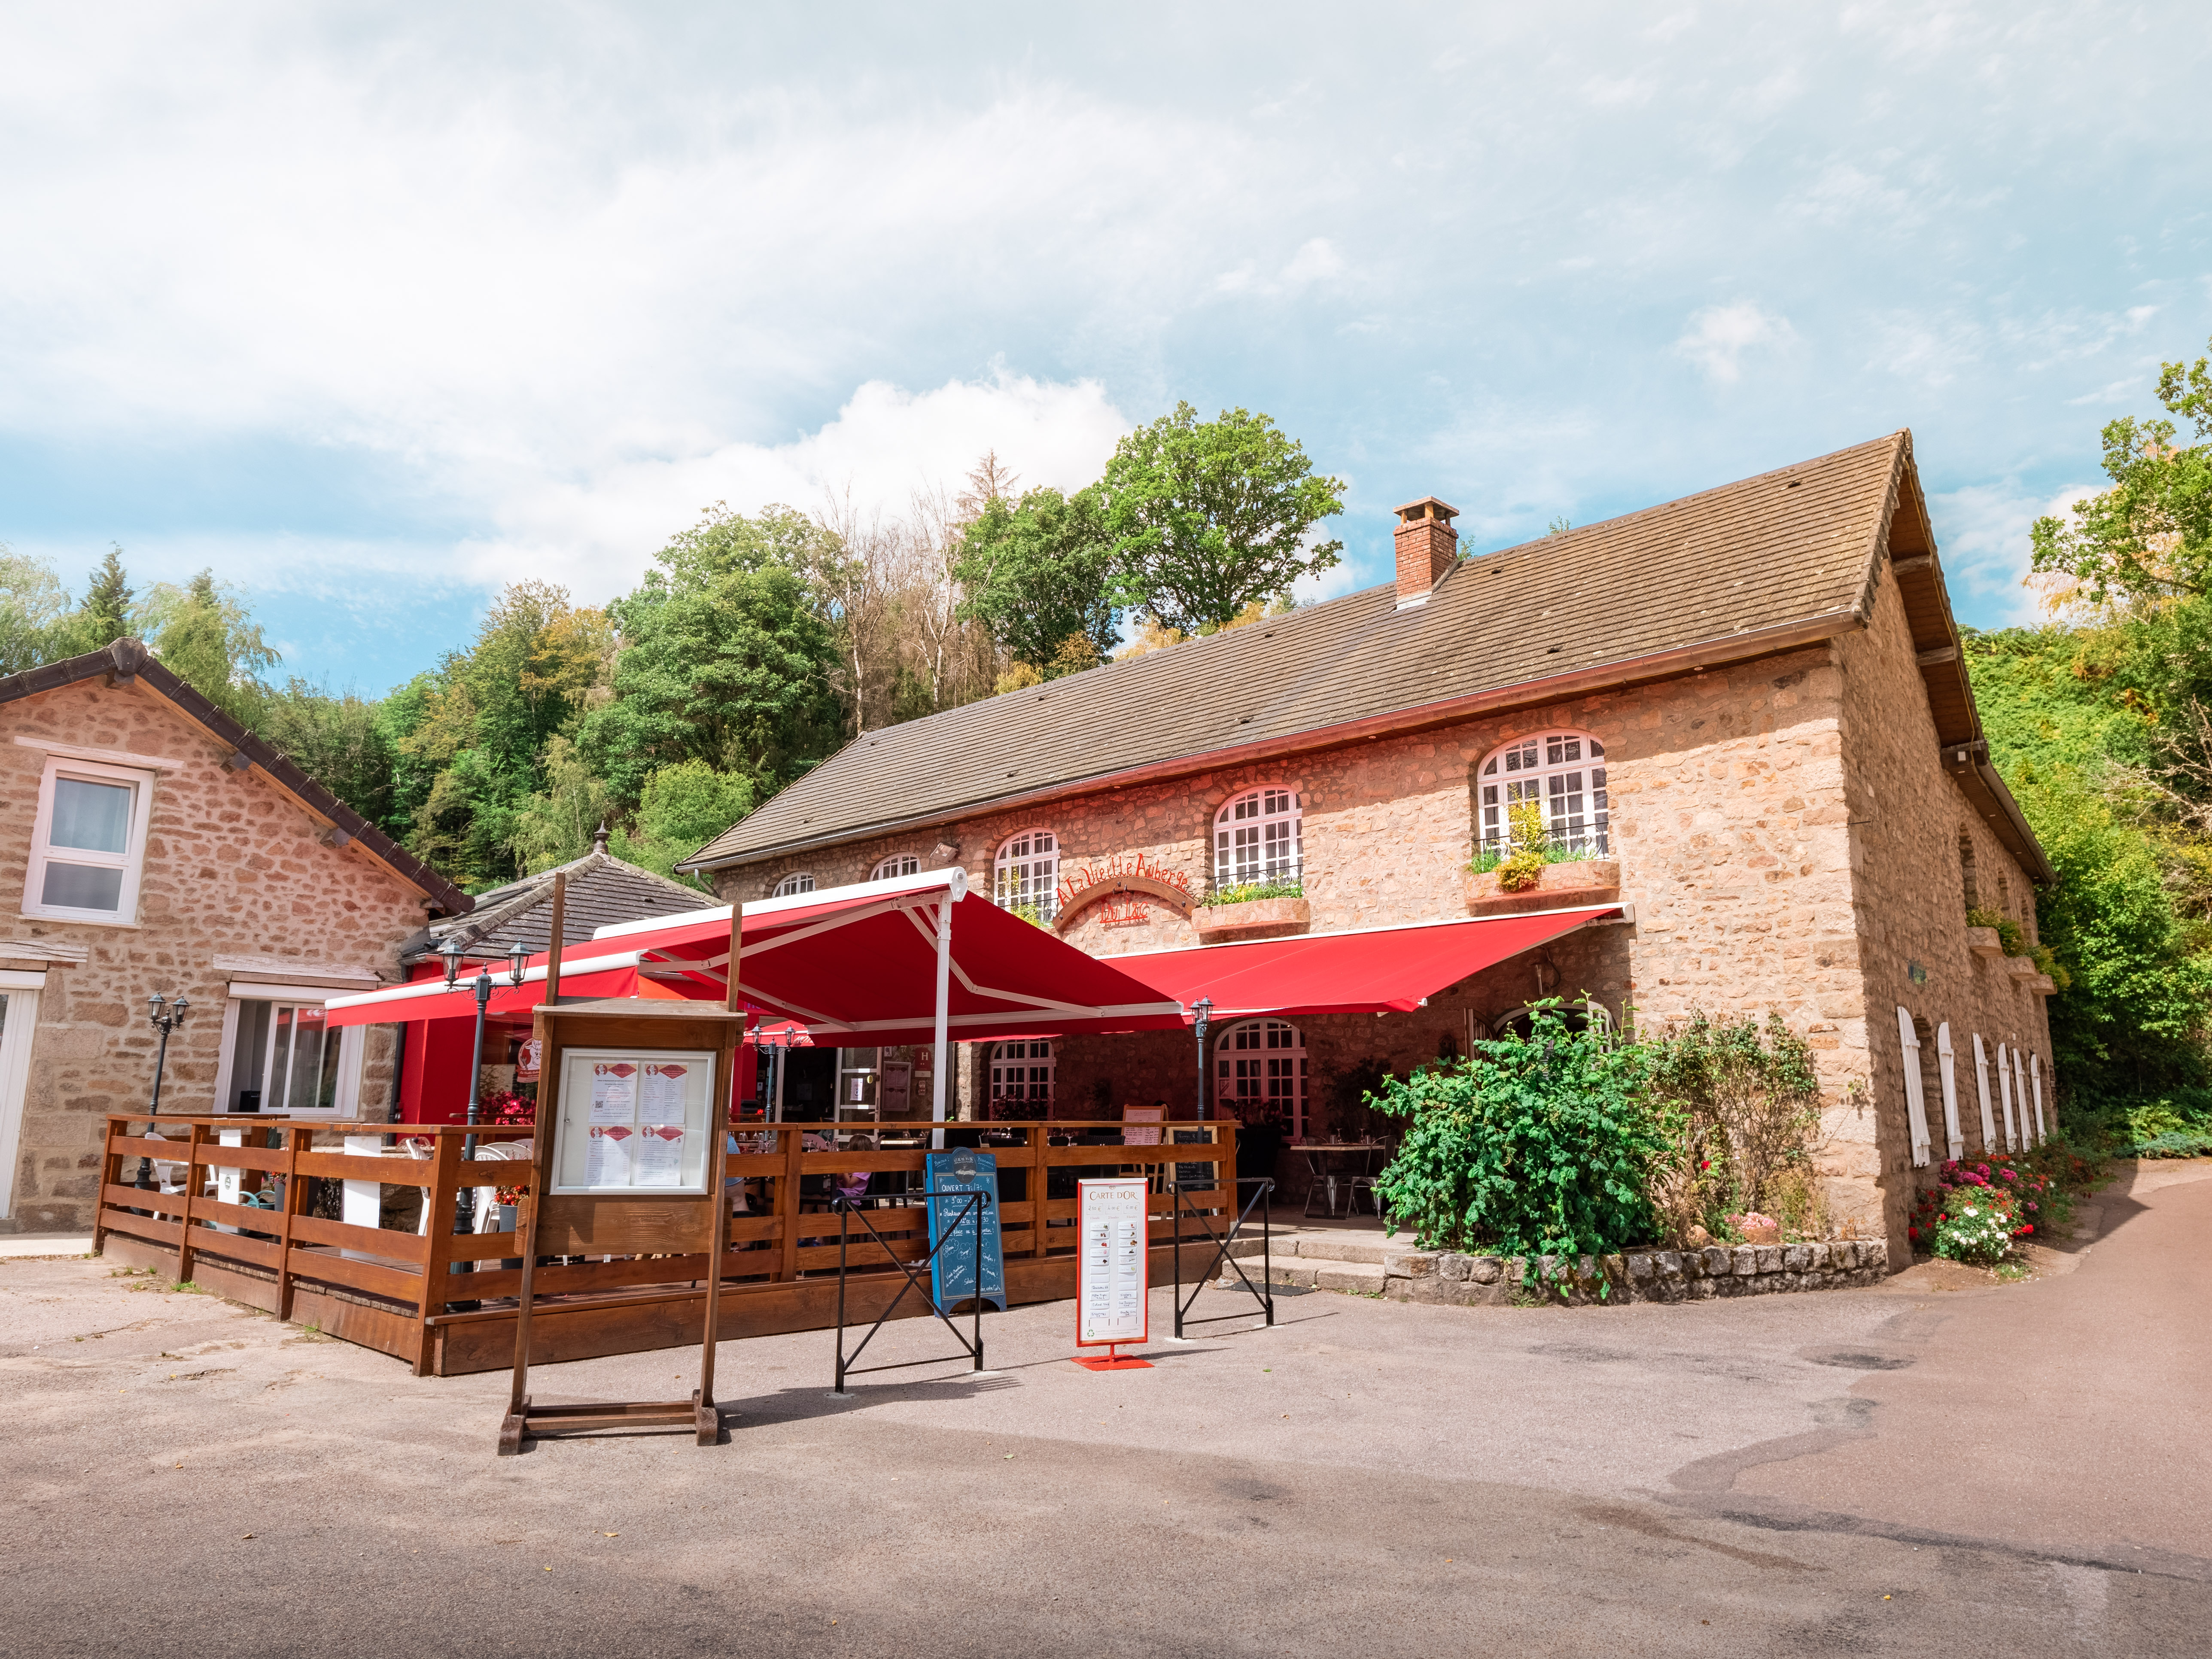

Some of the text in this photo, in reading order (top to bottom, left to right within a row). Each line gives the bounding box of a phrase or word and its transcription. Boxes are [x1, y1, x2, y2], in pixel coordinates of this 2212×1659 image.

[1056, 853, 1188, 907] A La Vieille Auberge
[922, 1052, 928, 1060] H
[1089, 1190, 1138, 1201] CARTE D'OR
